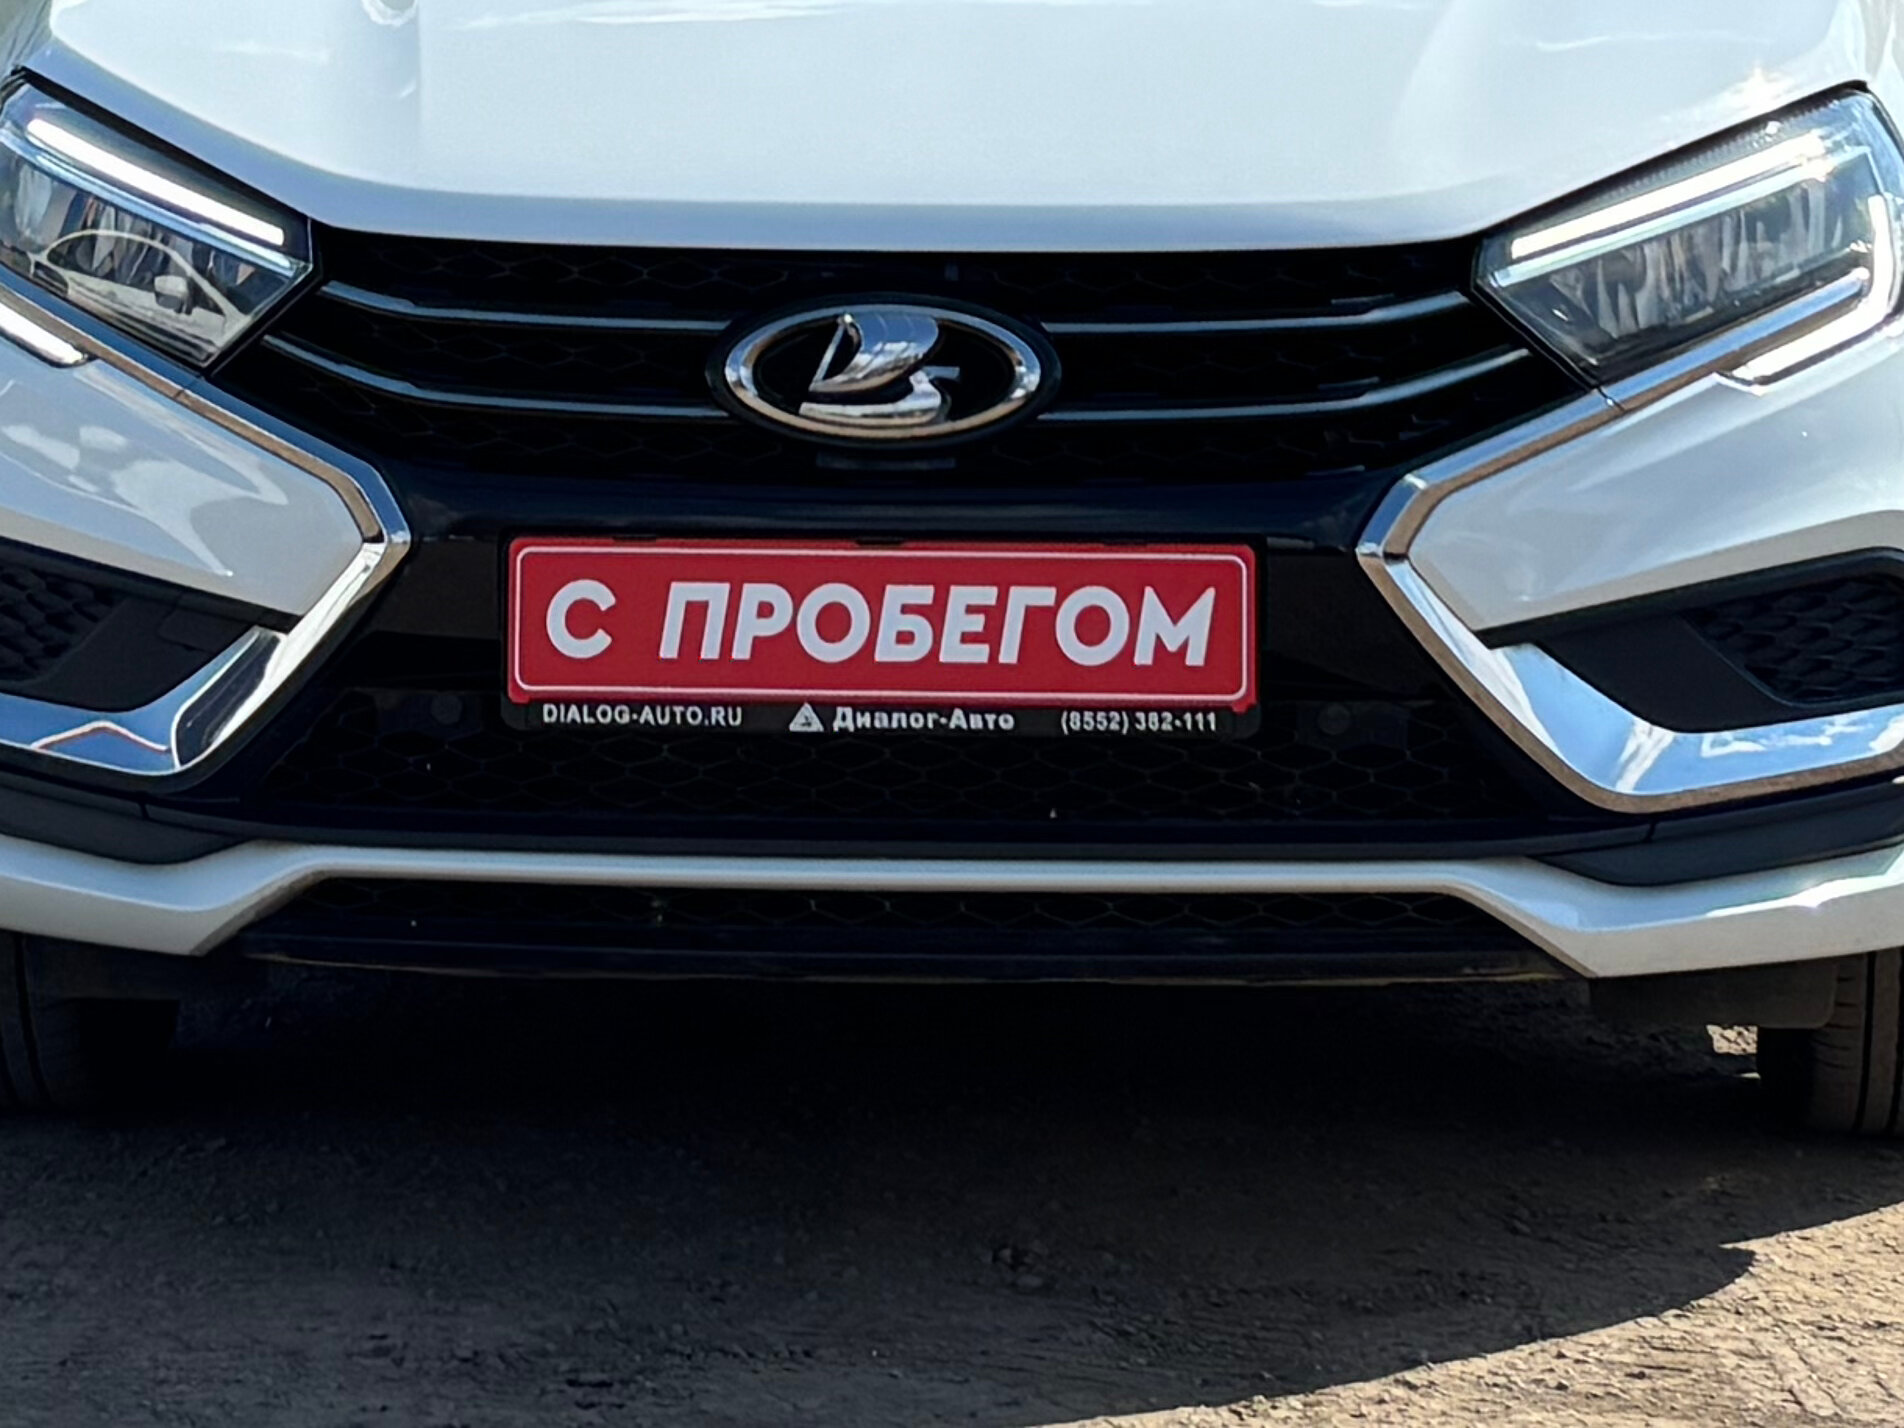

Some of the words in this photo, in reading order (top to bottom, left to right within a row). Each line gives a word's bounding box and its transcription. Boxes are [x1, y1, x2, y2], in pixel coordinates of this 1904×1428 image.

[545, 578, 617, 660] С
[658, 581, 1217, 667] ПРОБЕГОМ
[542, 703, 743, 727] DIALOG-AUTO.RU
[832, 706, 1015, 732] Диалог-Авто
[1060, 710, 1129, 735] (8552)
[1134, 711, 1217, 732] 382-111
